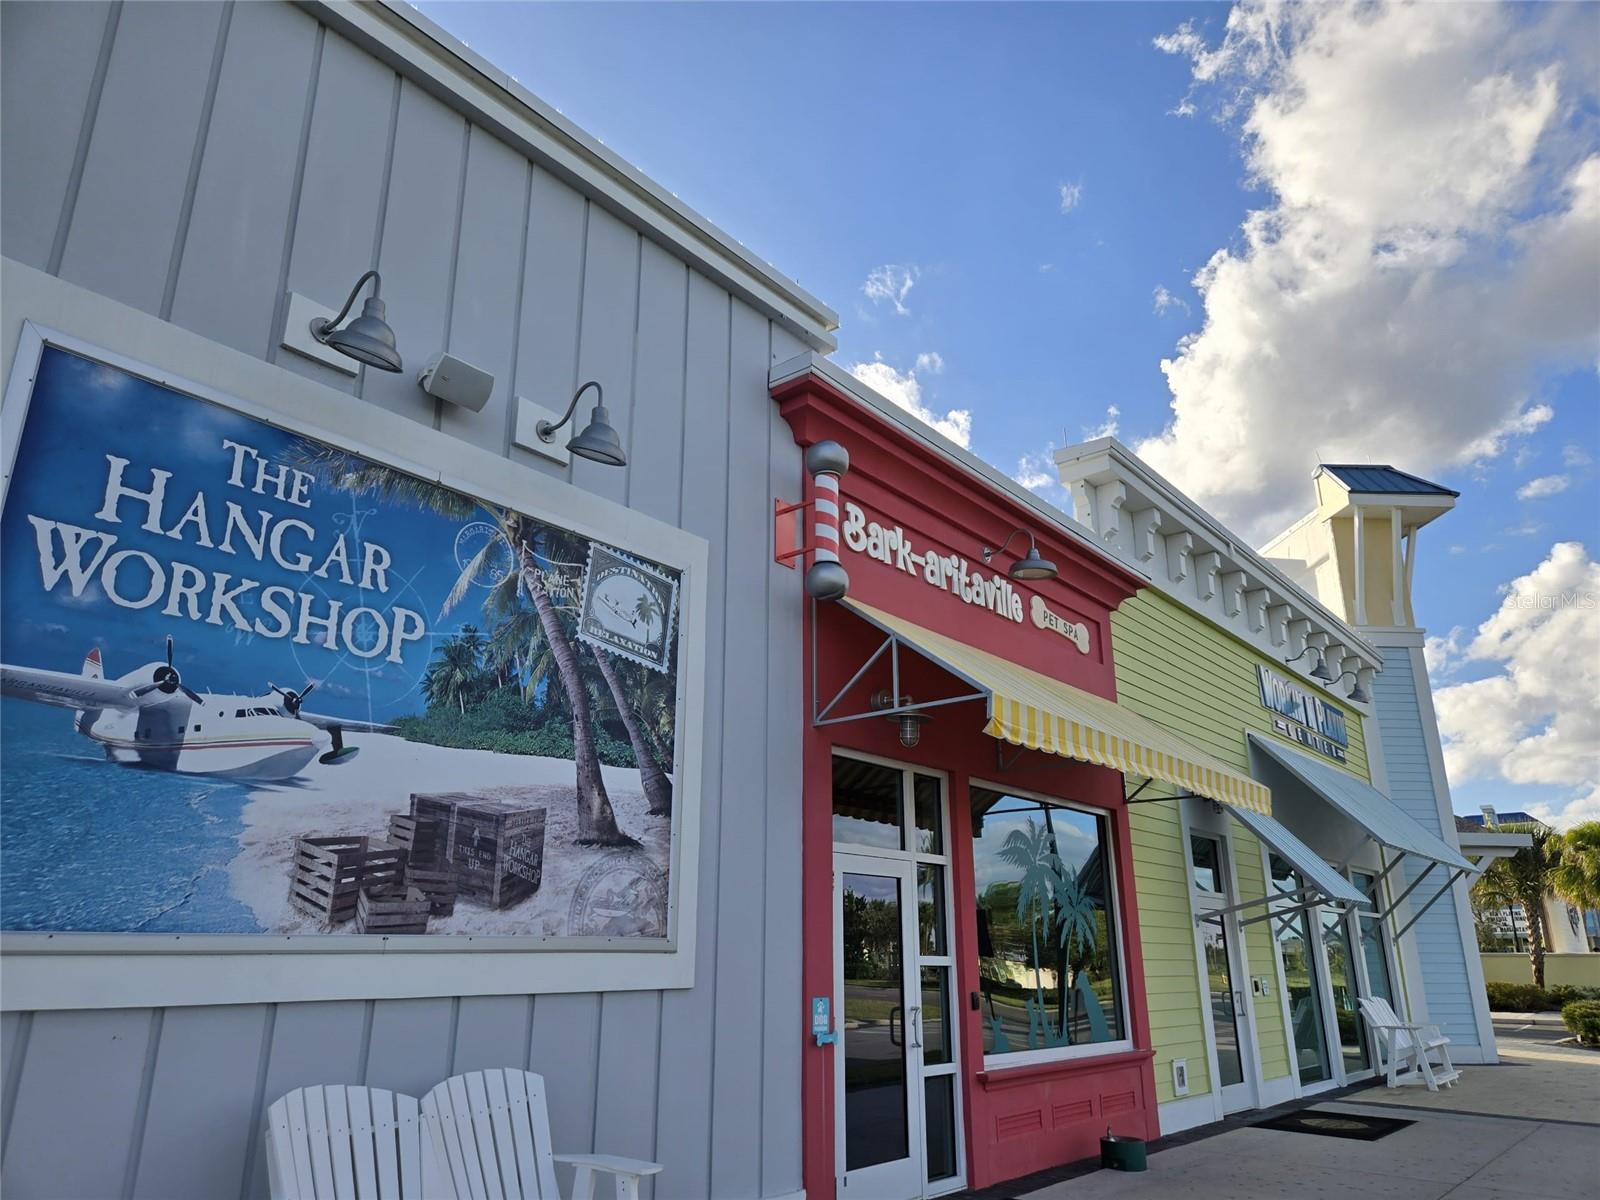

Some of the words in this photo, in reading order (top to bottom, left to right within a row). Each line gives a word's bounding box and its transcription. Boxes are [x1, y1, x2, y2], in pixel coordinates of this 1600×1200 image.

[222, 439, 316, 508] THE
[94, 454, 391, 593] HANGAR
[28, 514, 425, 665] WORKSHOP
[842, 501, 1024, 624] Bark-aritaville
[1043, 610, 1060, 629] PET
[1063, 622, 1079, 641] SPA
[503, 853, 541, 885] WORKSHOP
[509, 839, 538, 867] HANGAR
